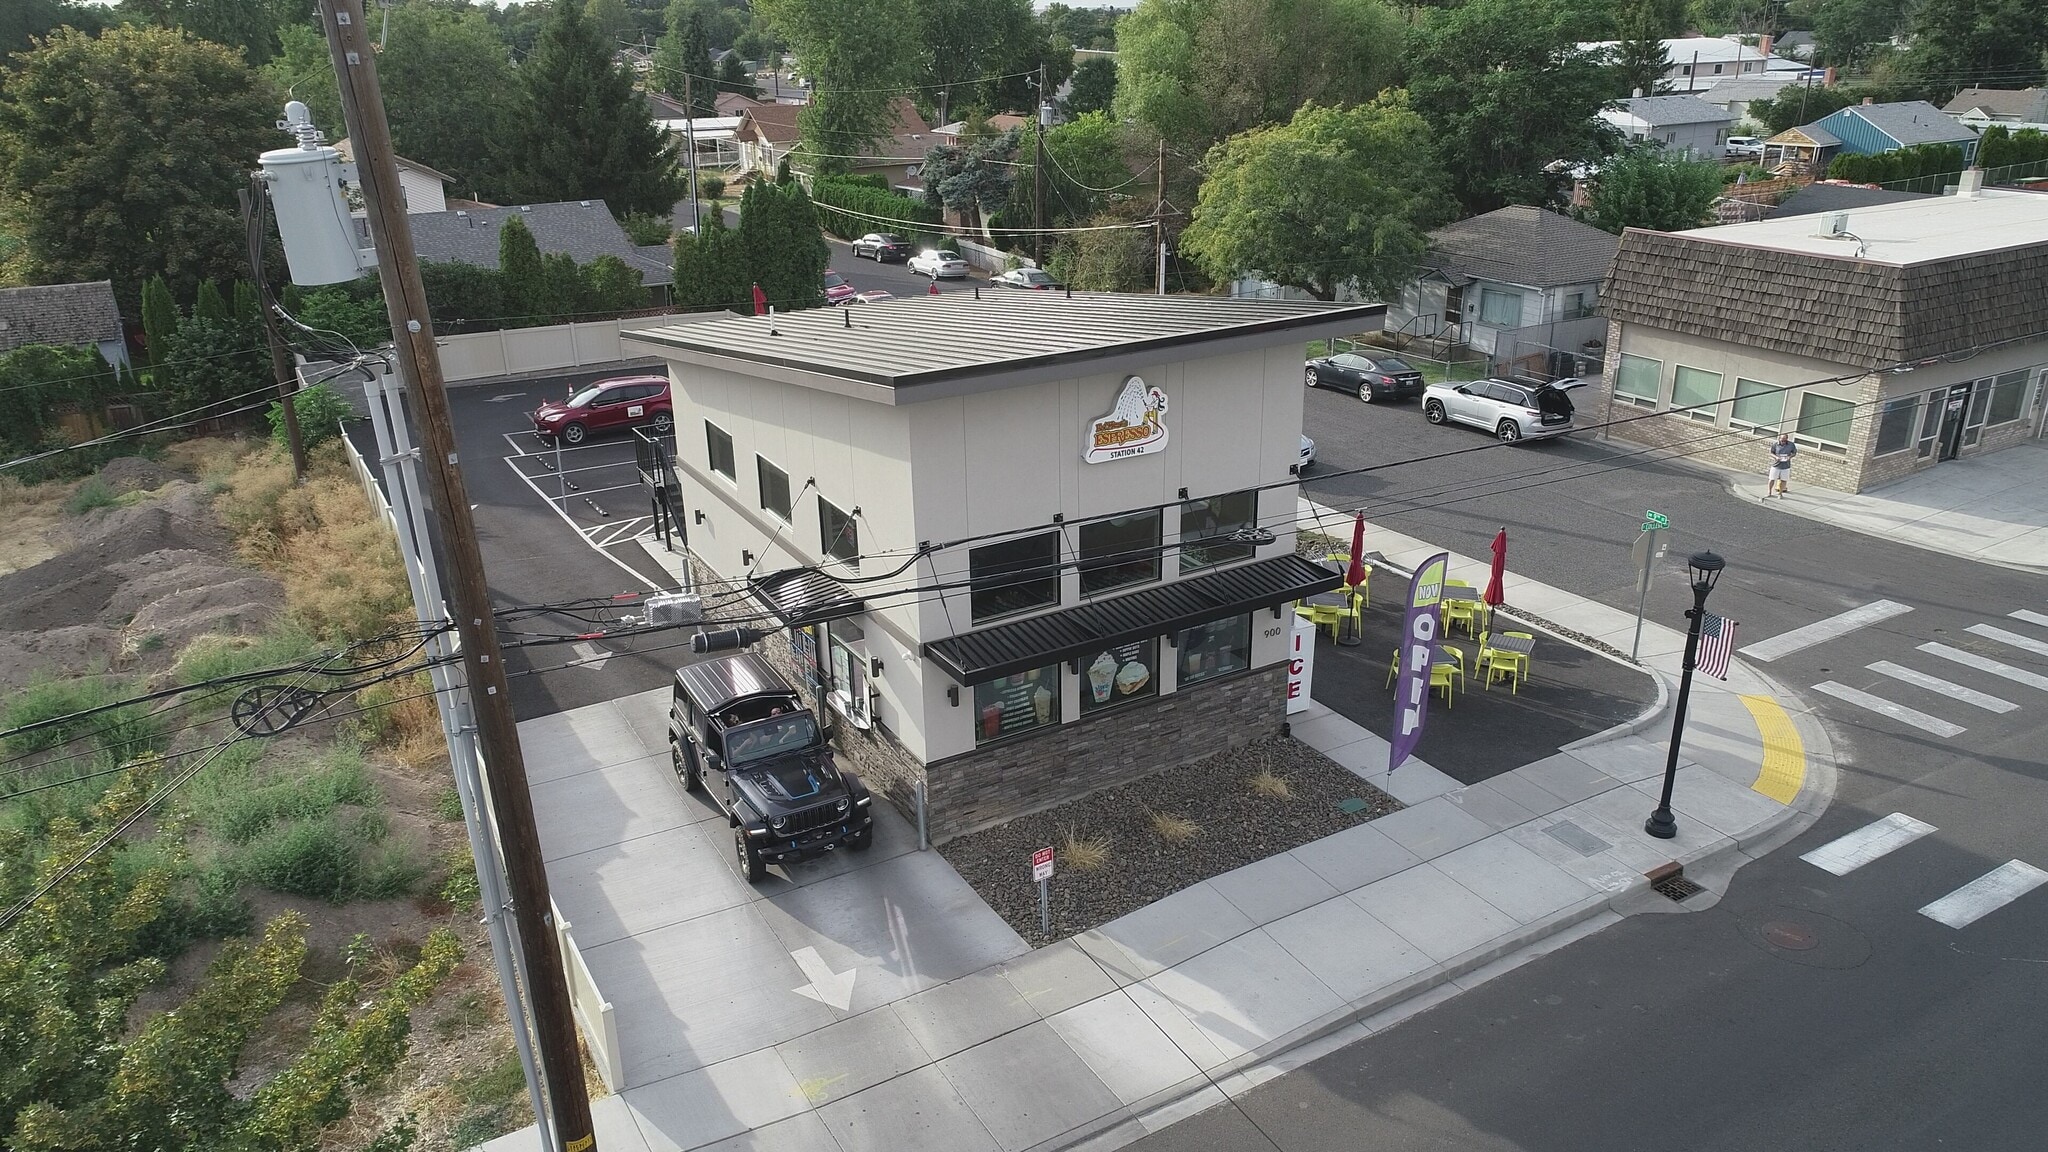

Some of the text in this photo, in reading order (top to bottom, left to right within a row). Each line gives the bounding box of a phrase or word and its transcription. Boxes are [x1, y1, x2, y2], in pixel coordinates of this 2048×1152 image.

[1110, 446, 1145, 459] STATION 42
[1264, 627, 1281, 638] 900
[1287, 634, 1304, 700] ICE
